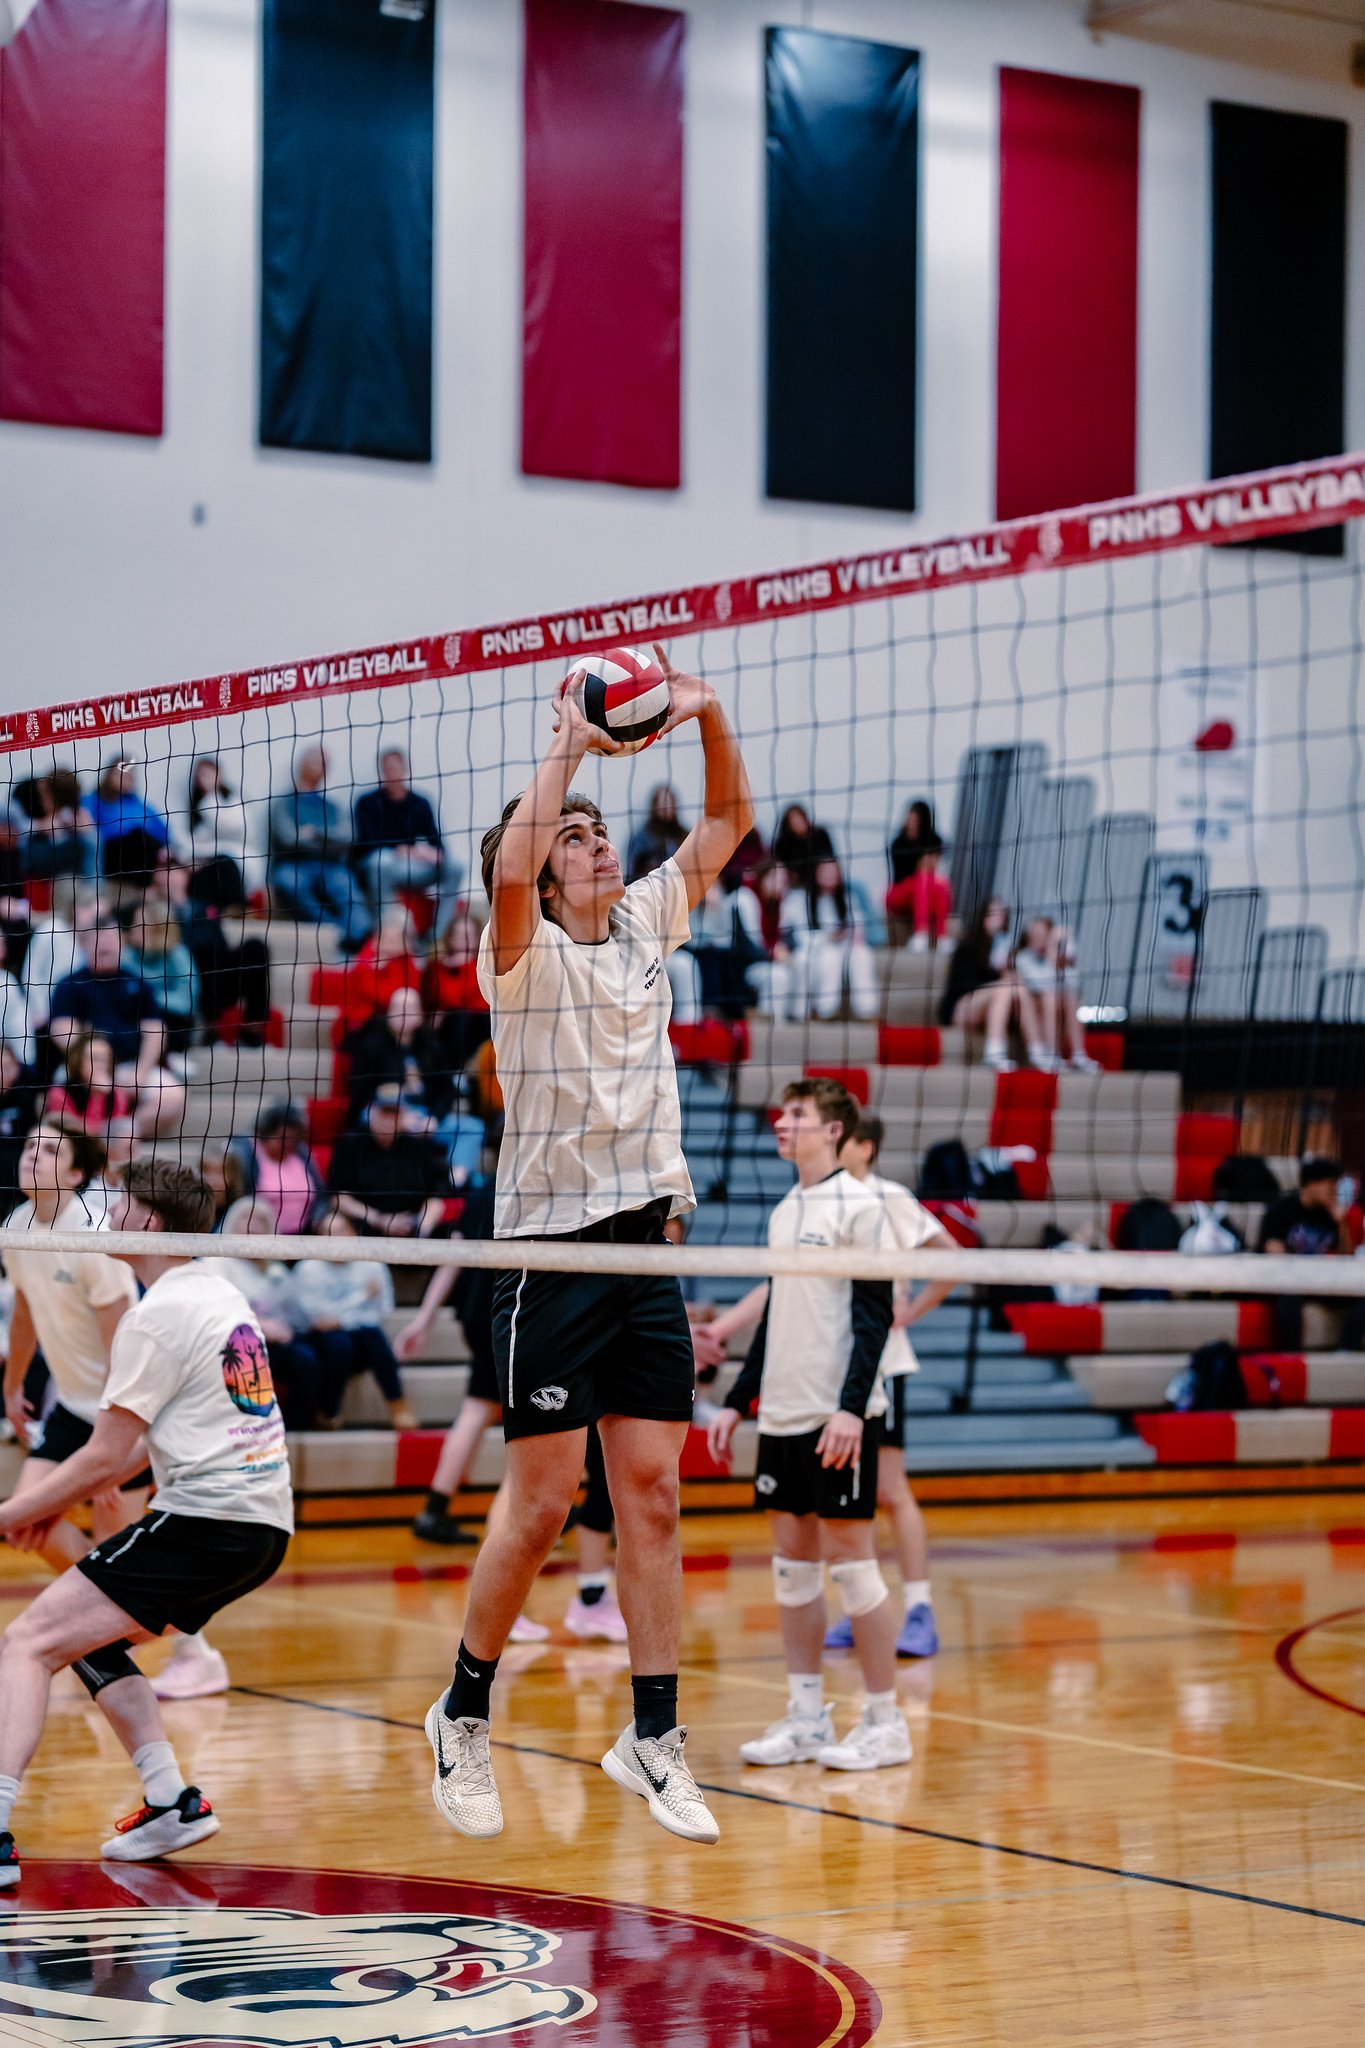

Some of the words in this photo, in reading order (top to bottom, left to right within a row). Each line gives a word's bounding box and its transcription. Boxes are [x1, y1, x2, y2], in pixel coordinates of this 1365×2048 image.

[1089, 503, 1182, 549] PNHS
[1187, 470, 1365, 530] VOLLEYBA
[757, 570, 831, 609] PNHS
[838, 536, 1011, 592] VOLLEYBALL
[482, 625, 544, 659] PNHS
[549, 597, 694, 645] VOLLEYBALL
[247, 669, 298, 697] PNHS
[303, 647, 427, 686] VOLLEYBALL
[51, 706, 96, 733] PNHS
[100, 687, 203, 724] VOLLEYBALL
[1164, 874, 1195, 935] 3
